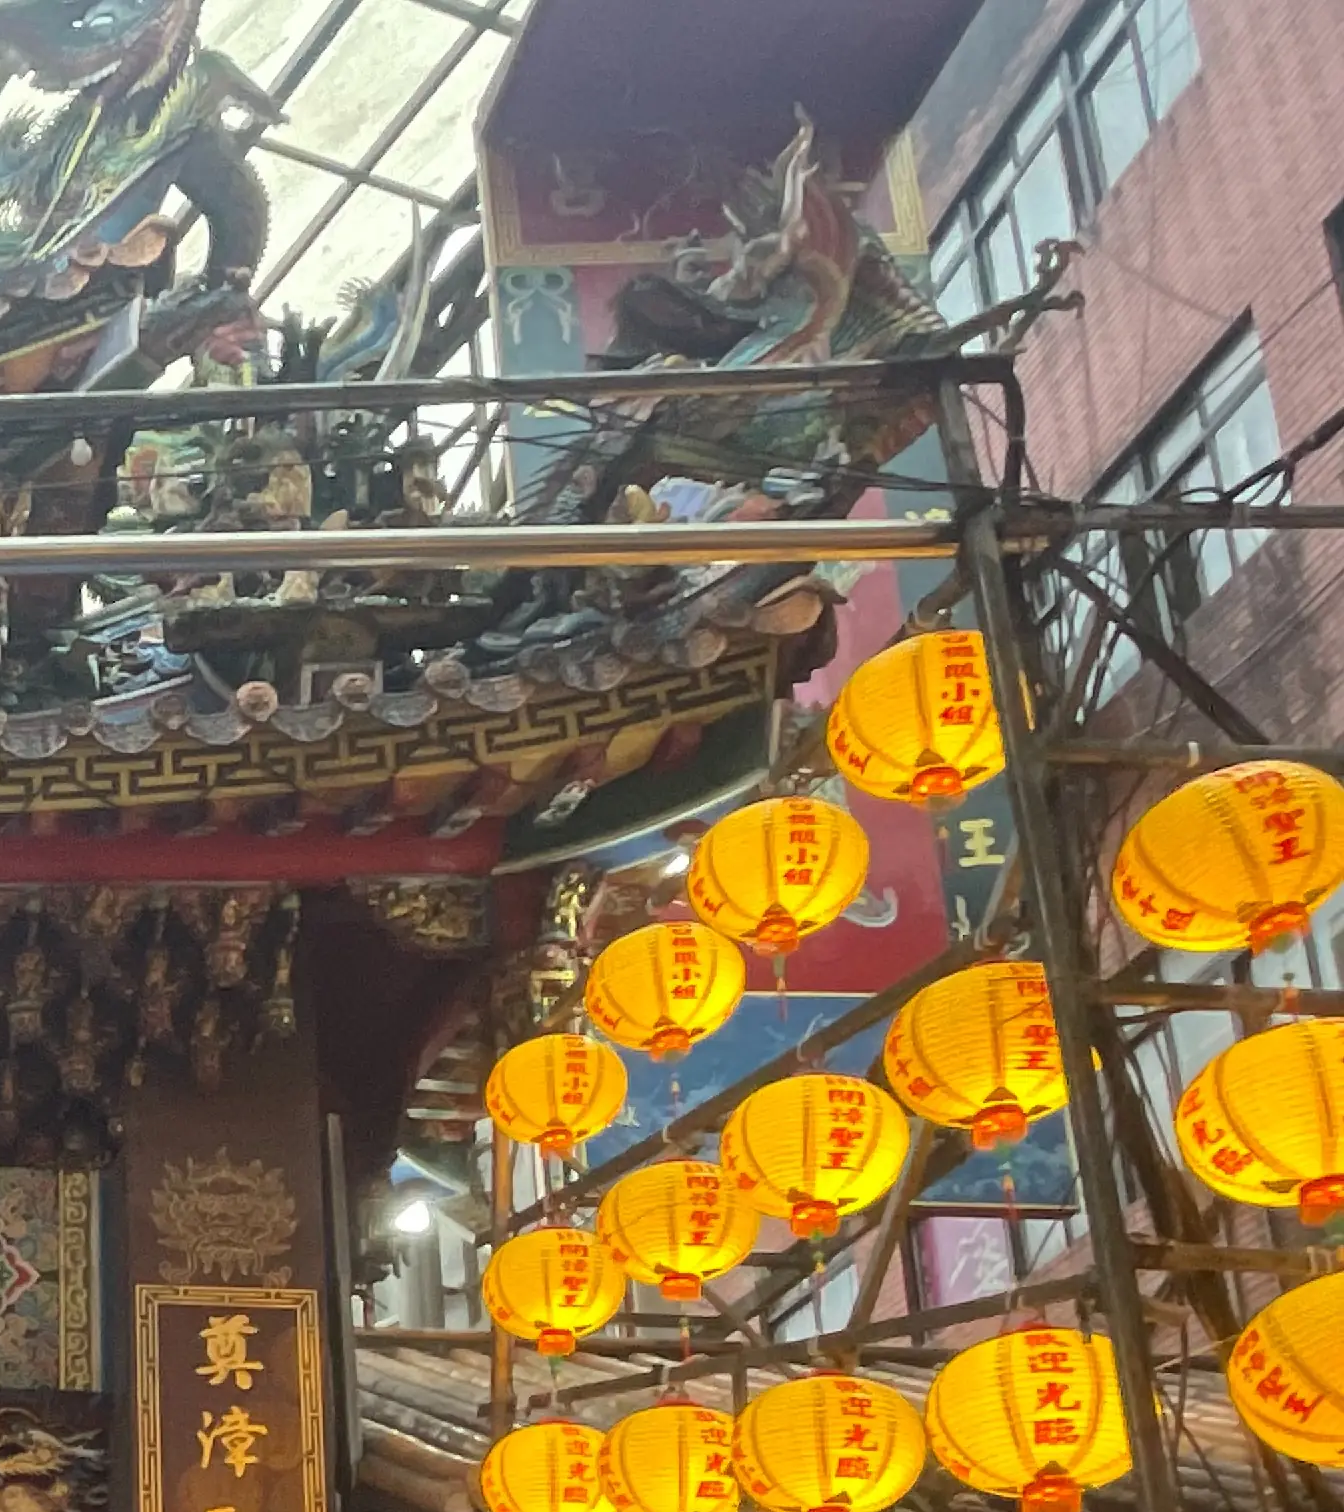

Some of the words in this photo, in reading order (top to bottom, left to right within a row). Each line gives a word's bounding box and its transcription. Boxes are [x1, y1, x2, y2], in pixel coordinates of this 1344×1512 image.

[820, 1088, 866, 1170] 開漳聖王
[684, 1175, 720, 1246] 開漳聖王
[559, 1243, 589, 1307] 開漳聖王
[1023, 1331, 1083, 1446] 歡迎光臨
[834, 1379, 879, 1481] 歡迎光臨
